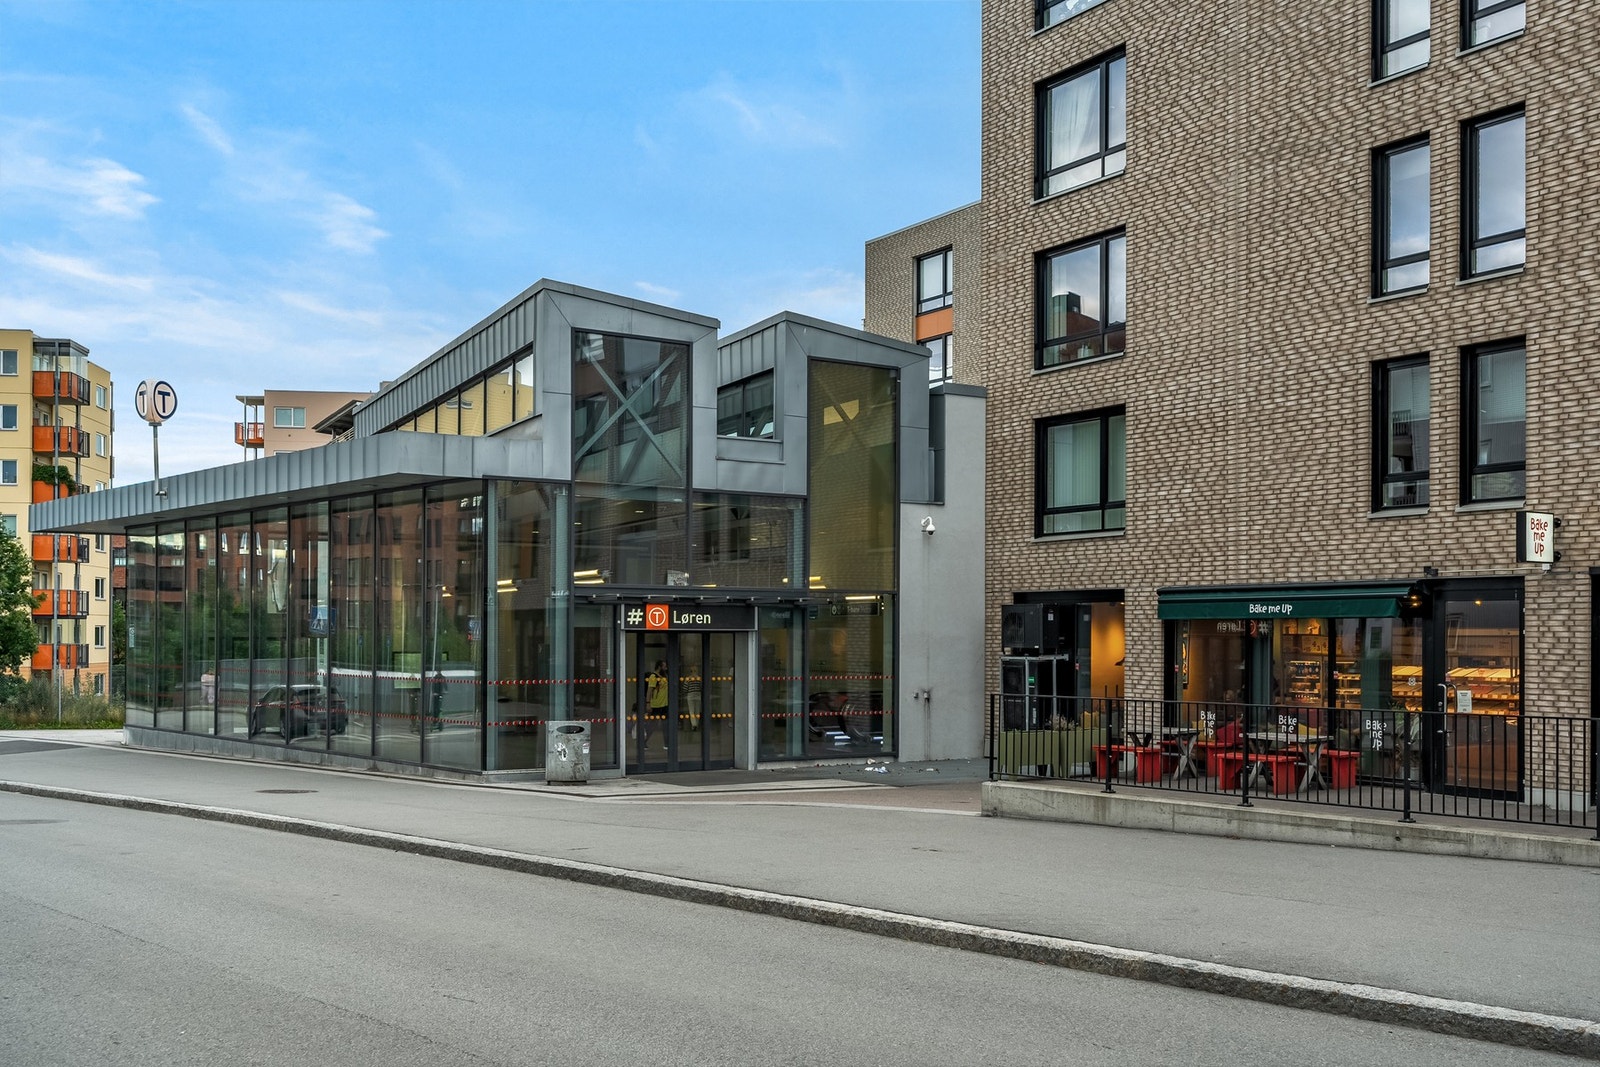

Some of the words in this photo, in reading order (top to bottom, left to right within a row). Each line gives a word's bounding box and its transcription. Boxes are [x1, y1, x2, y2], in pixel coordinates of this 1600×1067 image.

[157, 390, 171, 413] T
[1530, 517, 1549, 531] Bake
[1533, 531, 1546, 541] me
[1249, 603, 1268, 614] Bake
[1268, 605, 1281, 613] me
[673, 610, 711, 624] Løren
